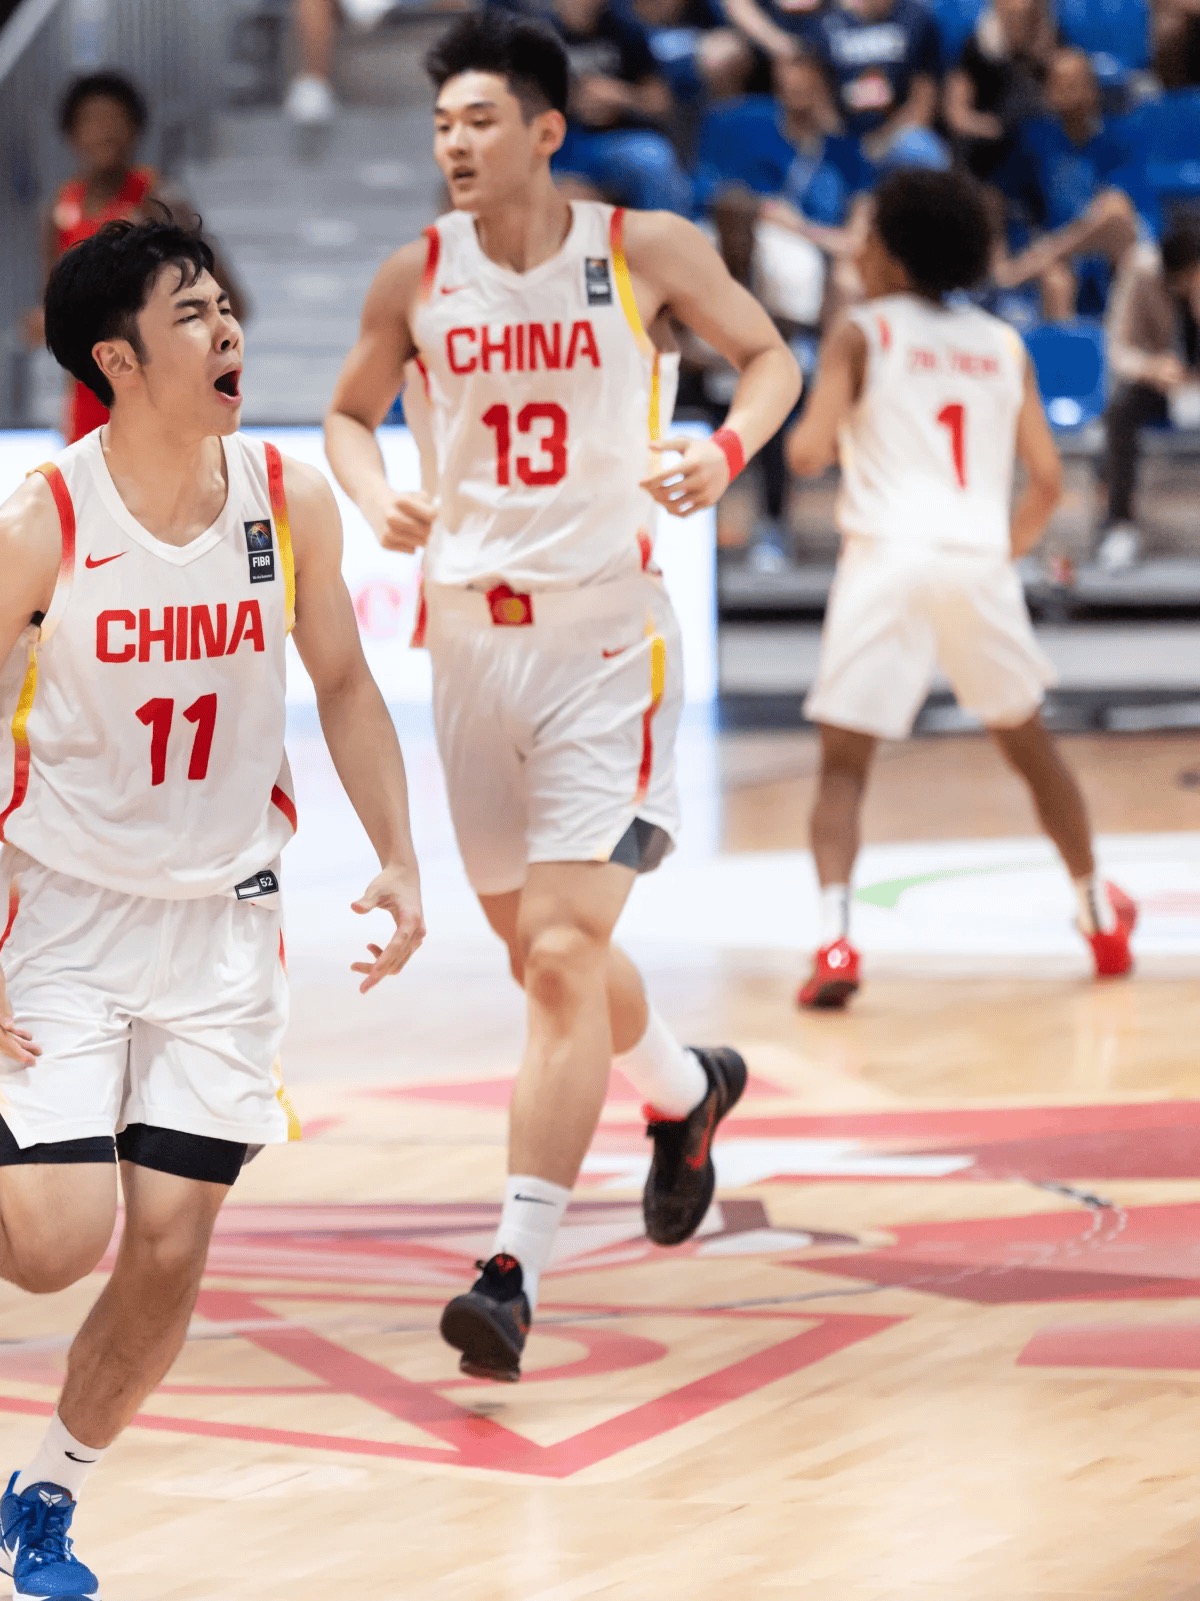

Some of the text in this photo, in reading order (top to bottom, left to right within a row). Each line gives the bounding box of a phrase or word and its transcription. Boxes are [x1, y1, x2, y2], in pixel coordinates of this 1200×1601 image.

[445, 319, 602, 377] CHINA
[481, 401, 569, 488] 13
[937, 403, 966, 491] 1
[252, 555, 271, 568] FIBA
[95, 599, 266, 664] CHINA
[134, 692, 218, 787] 11
[259, 876, 274, 888] 52
